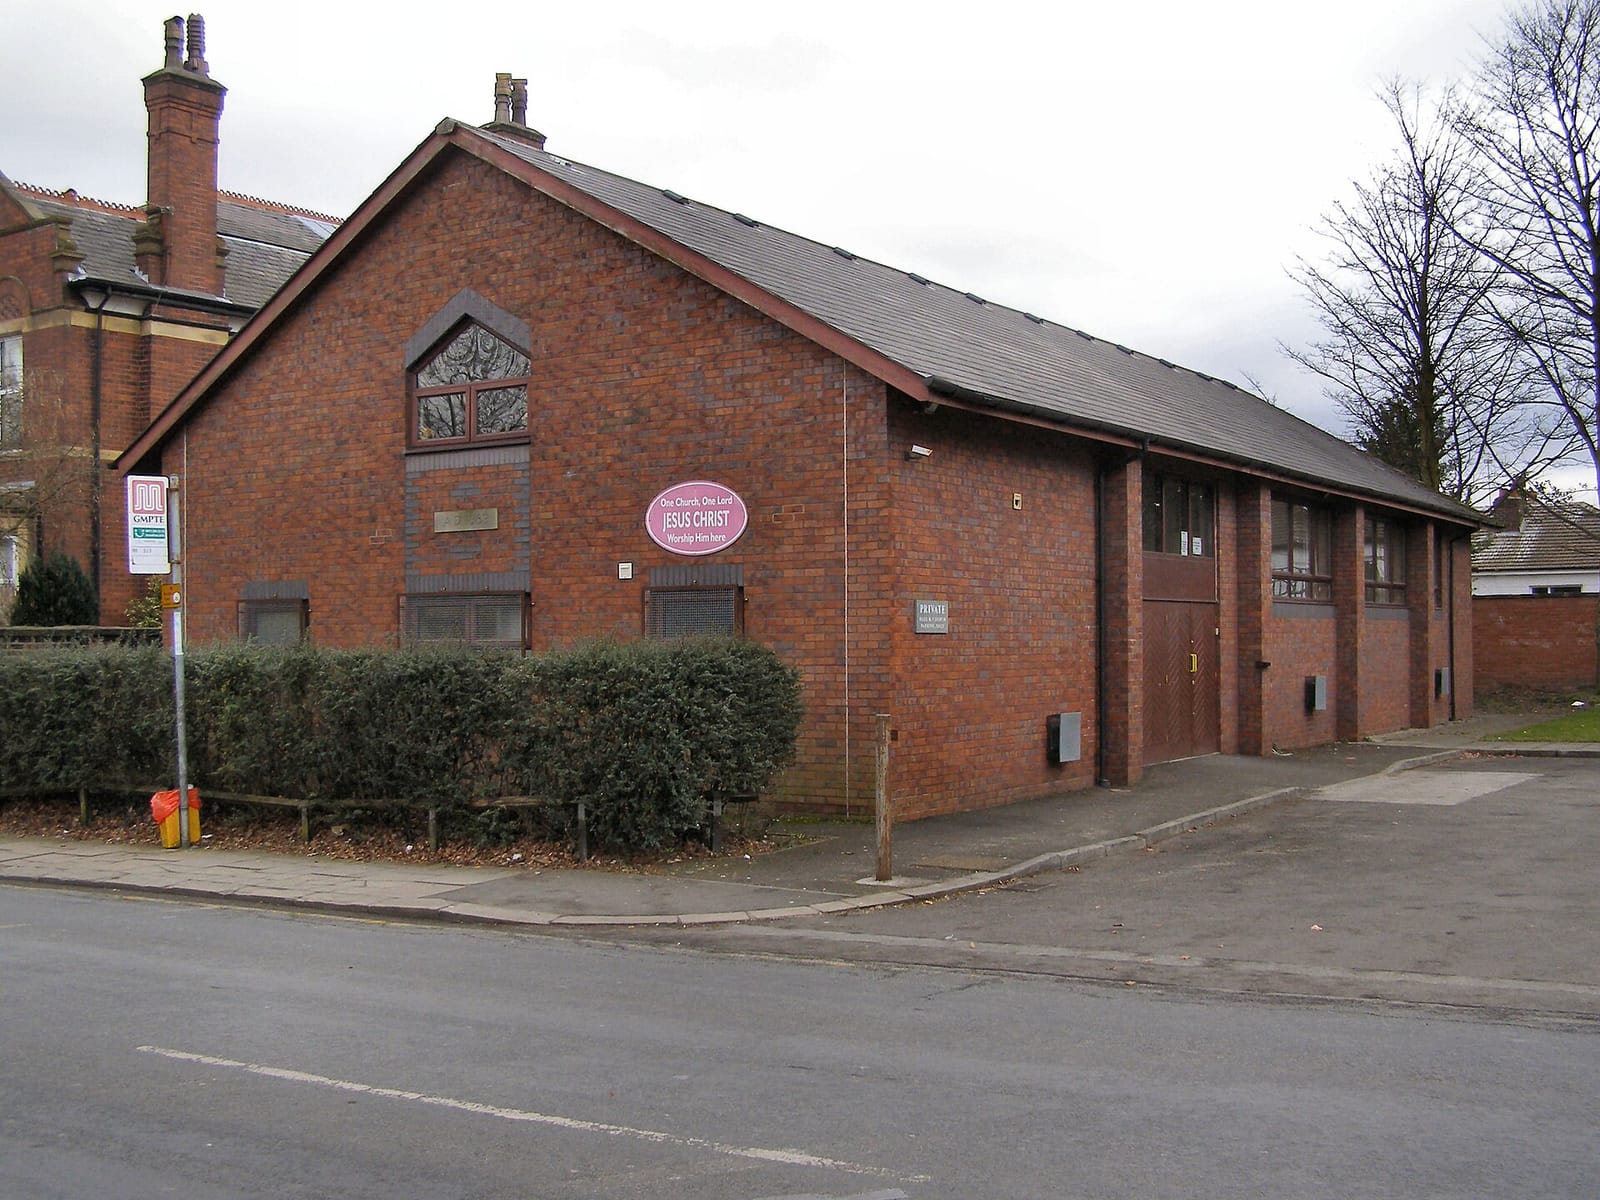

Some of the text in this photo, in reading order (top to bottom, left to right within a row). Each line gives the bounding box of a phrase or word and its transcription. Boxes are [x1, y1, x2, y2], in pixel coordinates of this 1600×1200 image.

[660, 496, 733, 507] One Church, One Lord
[133, 515, 165, 523] GMPTE
[662, 510, 730, 533] JESUS CHRIST
[667, 533, 726, 544] Worship Him here
[919, 604, 946, 614] PRIVATE
